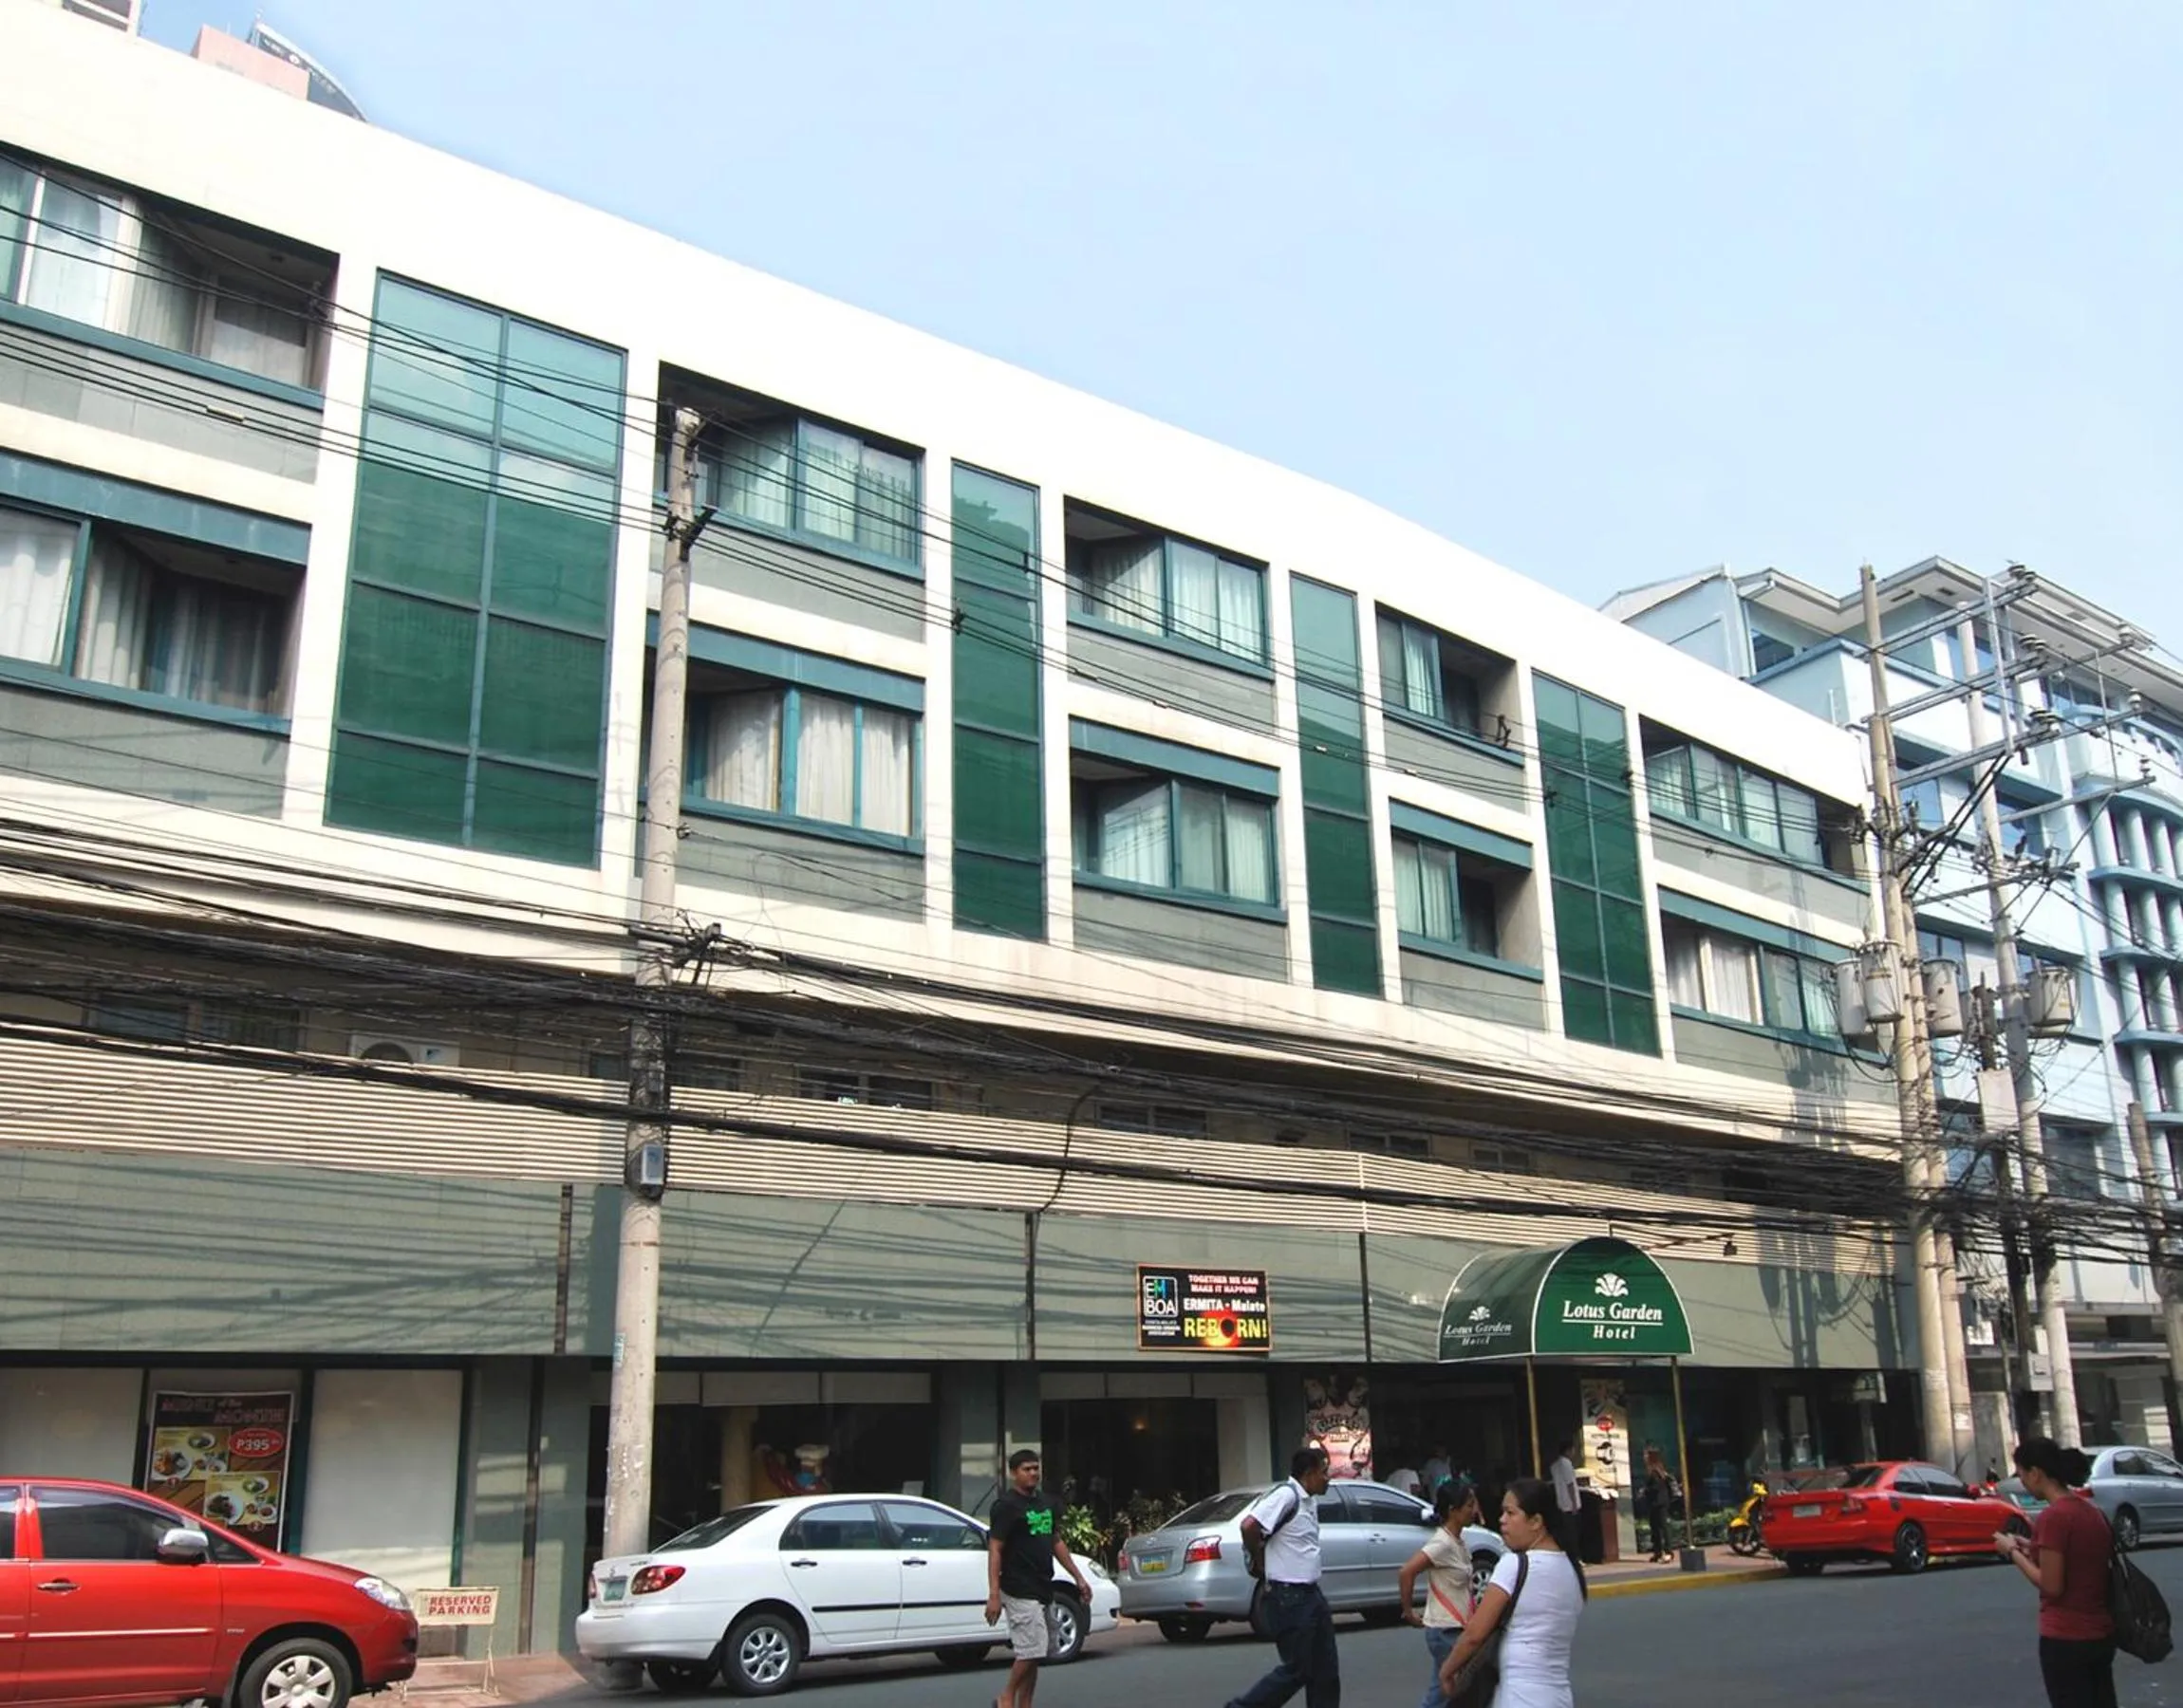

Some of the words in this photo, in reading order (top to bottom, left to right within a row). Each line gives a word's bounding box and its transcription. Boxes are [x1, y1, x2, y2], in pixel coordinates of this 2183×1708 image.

[1188, 1274, 1227, 1285] TOGETHER
[1242, 1276, 1259, 1286] CAN
[1190, 1284, 1213, 1293] MAKE
[1146, 1299, 1176, 1314] BOA
[1183, 1297, 1224, 1311] ERMITA
[1231, 1298, 1265, 1312] Malate
[1562, 1300, 1605, 1319] Lotus
[1609, 1302, 1663, 1321] Garden
[1184, 1316, 1267, 1339] REBORN!
[1445, 1324, 1474, 1334] Lotus
[1475, 1323, 1513, 1333] Garden
[1593, 1326, 1636, 1340] Hotel
[1461, 1336, 1491, 1346] Hotel
[429, 1595, 492, 1606] RESERVED
[428, 1606, 491, 1616] PARKING
